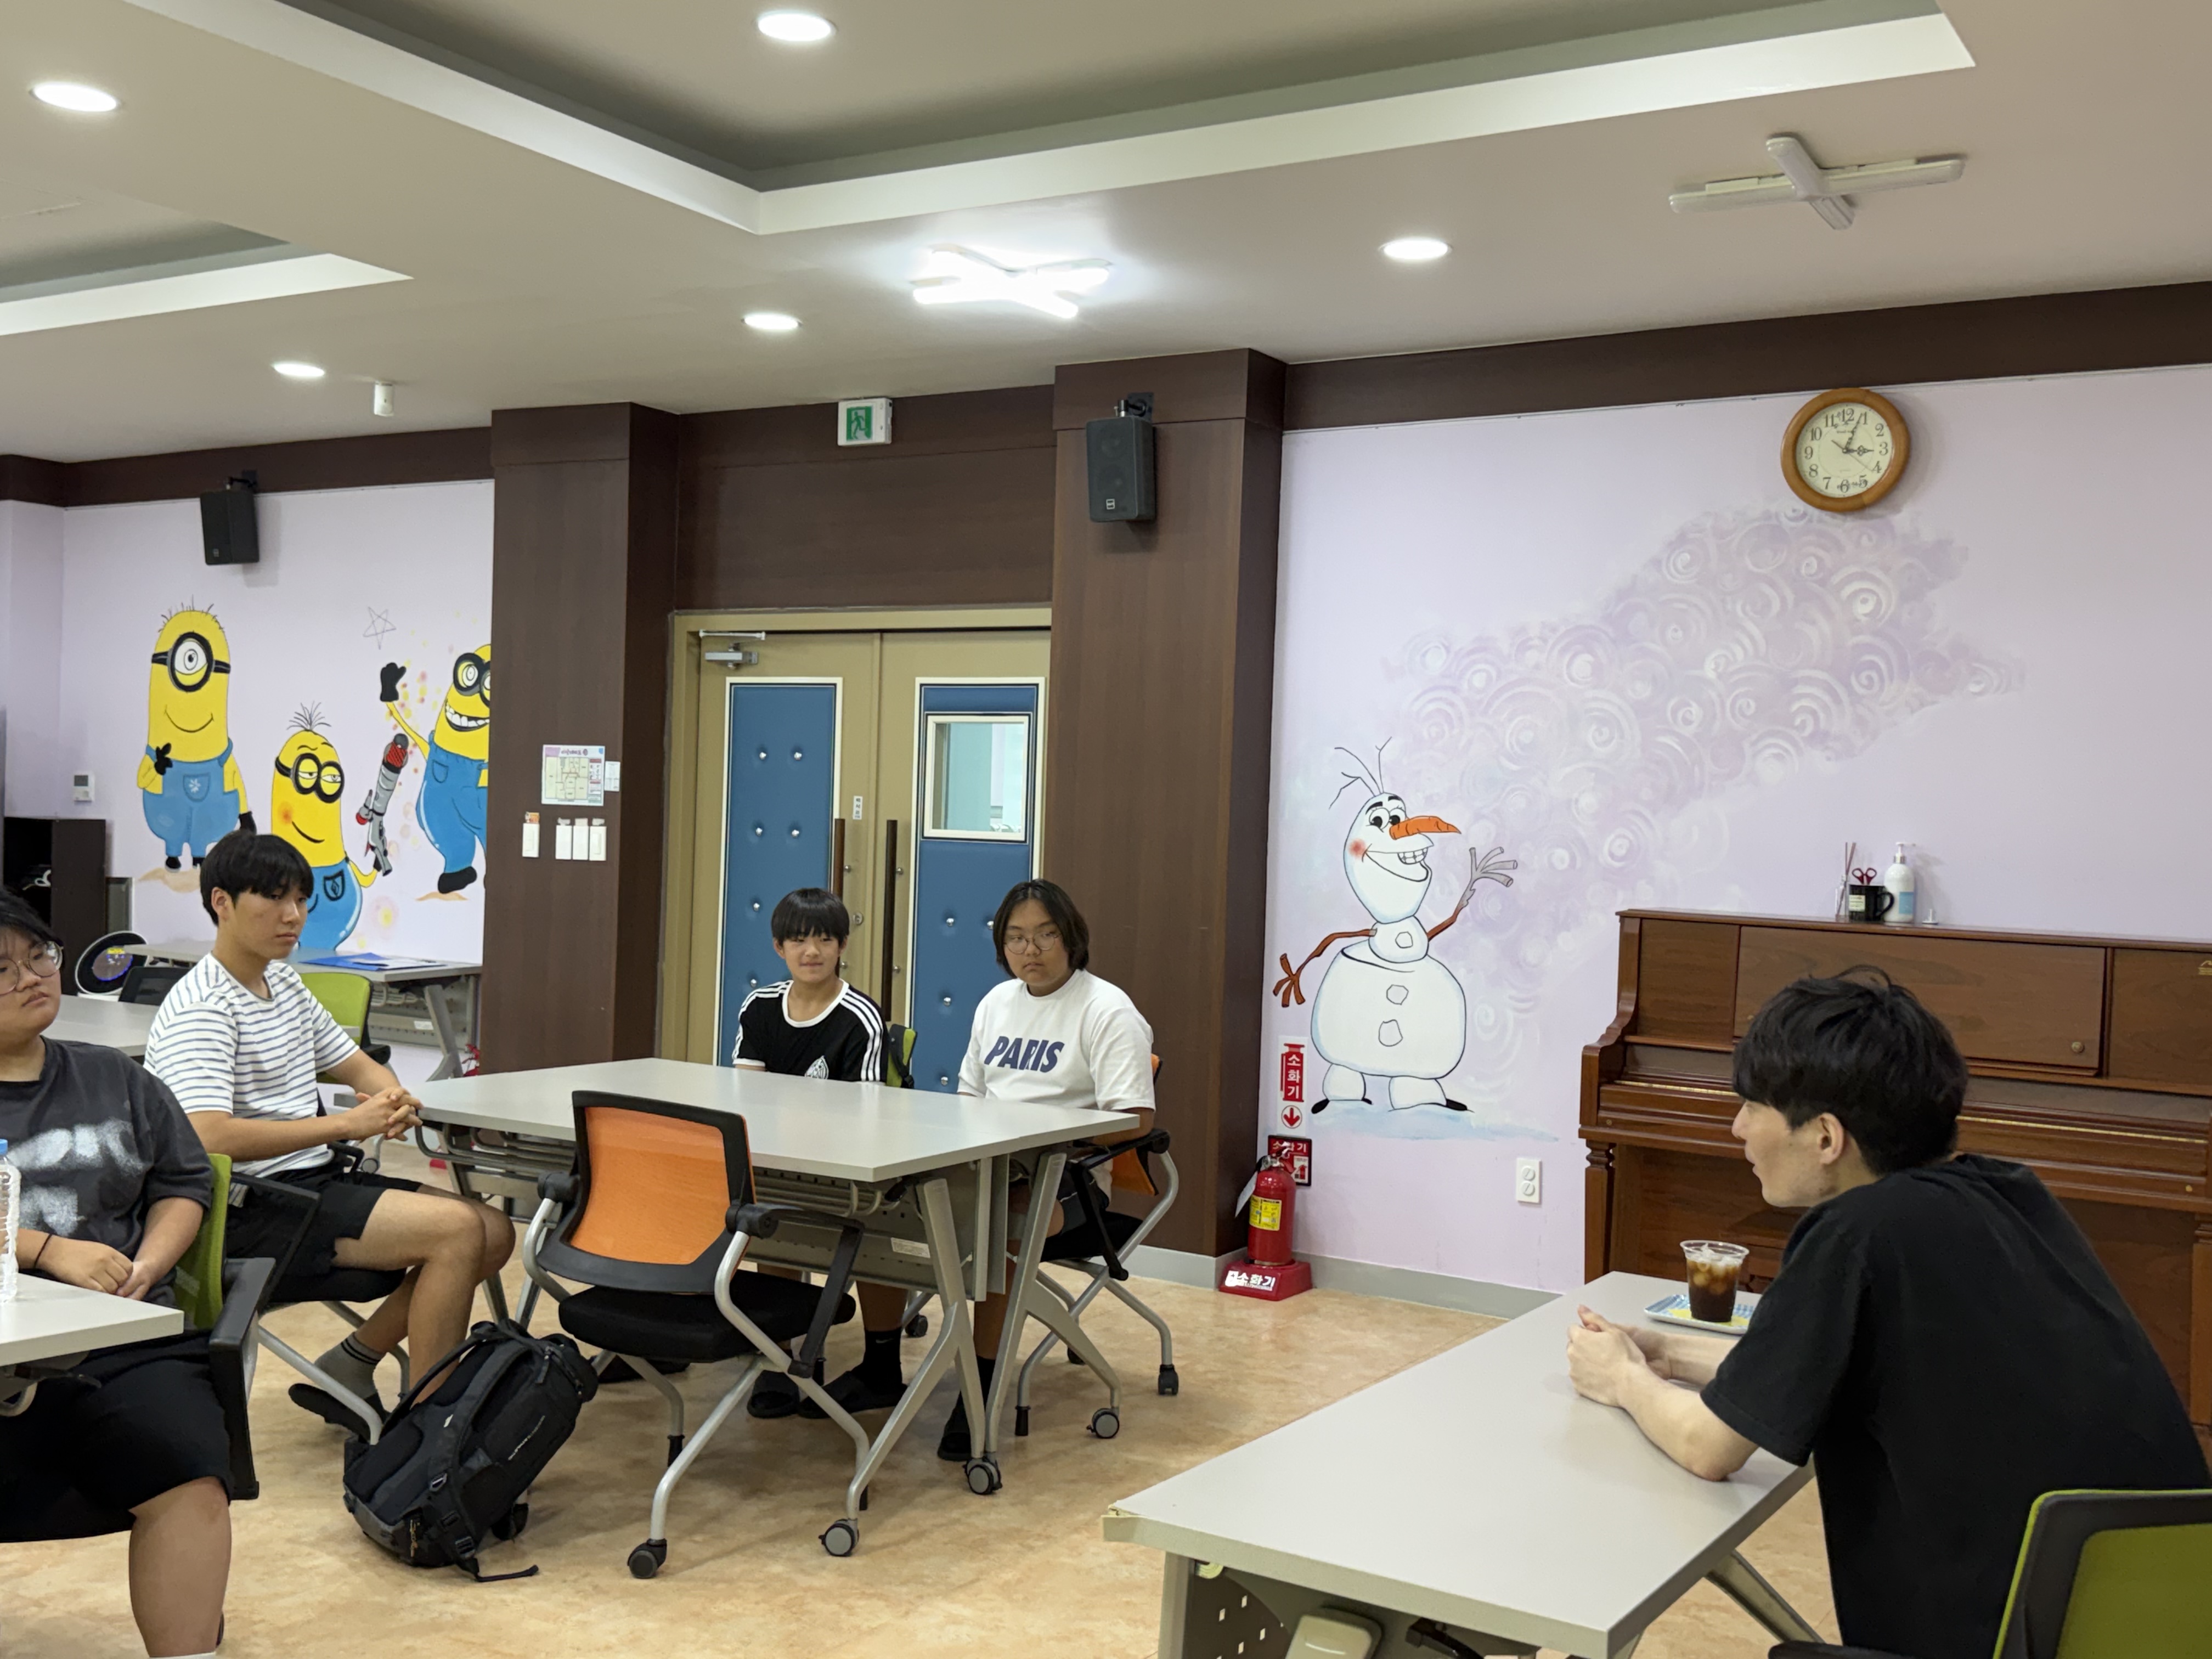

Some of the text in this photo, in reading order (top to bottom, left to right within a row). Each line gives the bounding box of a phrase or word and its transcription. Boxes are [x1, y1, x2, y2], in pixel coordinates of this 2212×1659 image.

[1825, 414, 1836, 427] 11
[1841, 408, 1854, 425] 12
[1863, 411, 1868, 425] 1
[1811, 427, 1822, 441] 10
[1875, 423, 1884, 437] 2
[1804, 447, 1813, 460] 9
[1879, 442, 1888, 455] 3
[1809, 464, 1818, 477] 8
[1872, 461, 1882, 473] 4
[1822, 477, 1831, 490] 7
[1839, 479, 1849, 493] 6
[1859, 475, 1867, 488] 5
[984, 1036, 1065, 1073] PARIS
[1287, 1054, 1301, 1099] 소화기
[1237, 1273, 1276, 1287] 소화기
